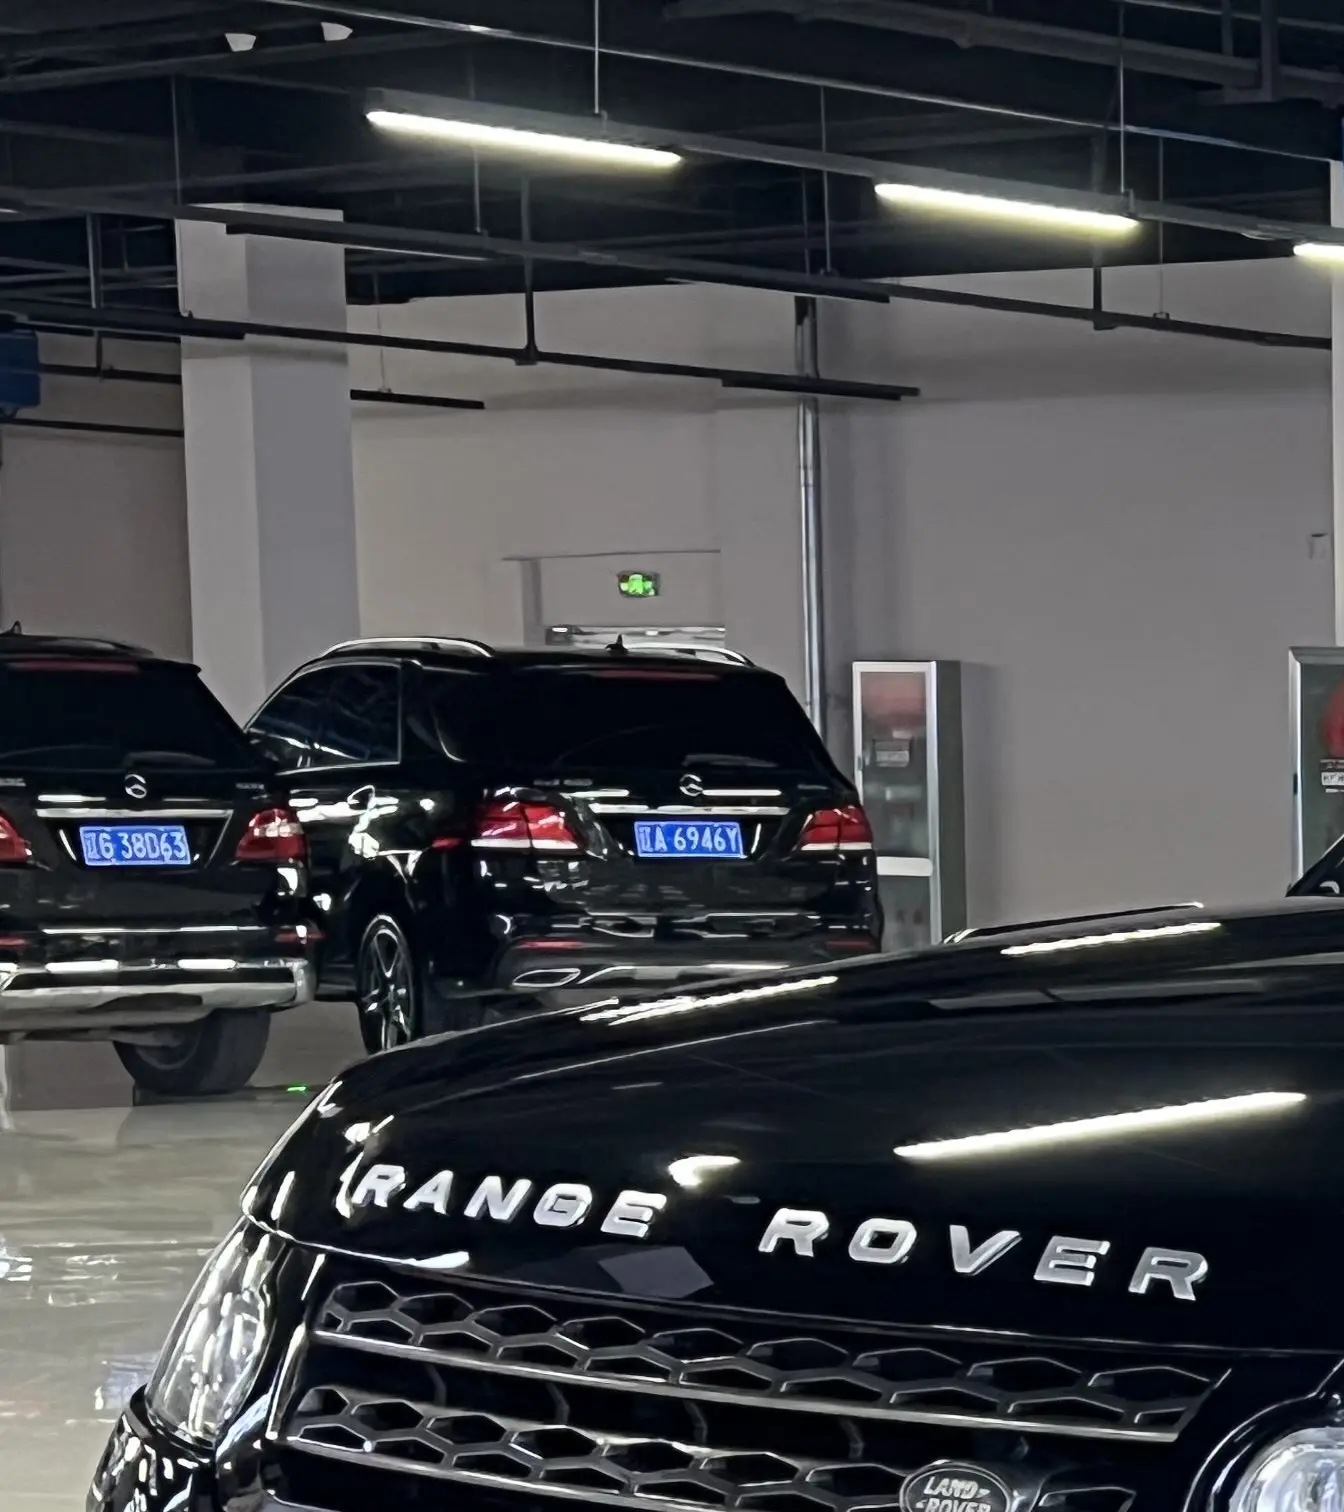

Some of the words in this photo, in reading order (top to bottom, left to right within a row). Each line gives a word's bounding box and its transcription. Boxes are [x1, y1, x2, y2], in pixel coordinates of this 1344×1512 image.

[352, 1163, 668, 1239] RANGE
[757, 1206, 1210, 1302] ROVER
[923, 1476, 980, 1500] LAND
